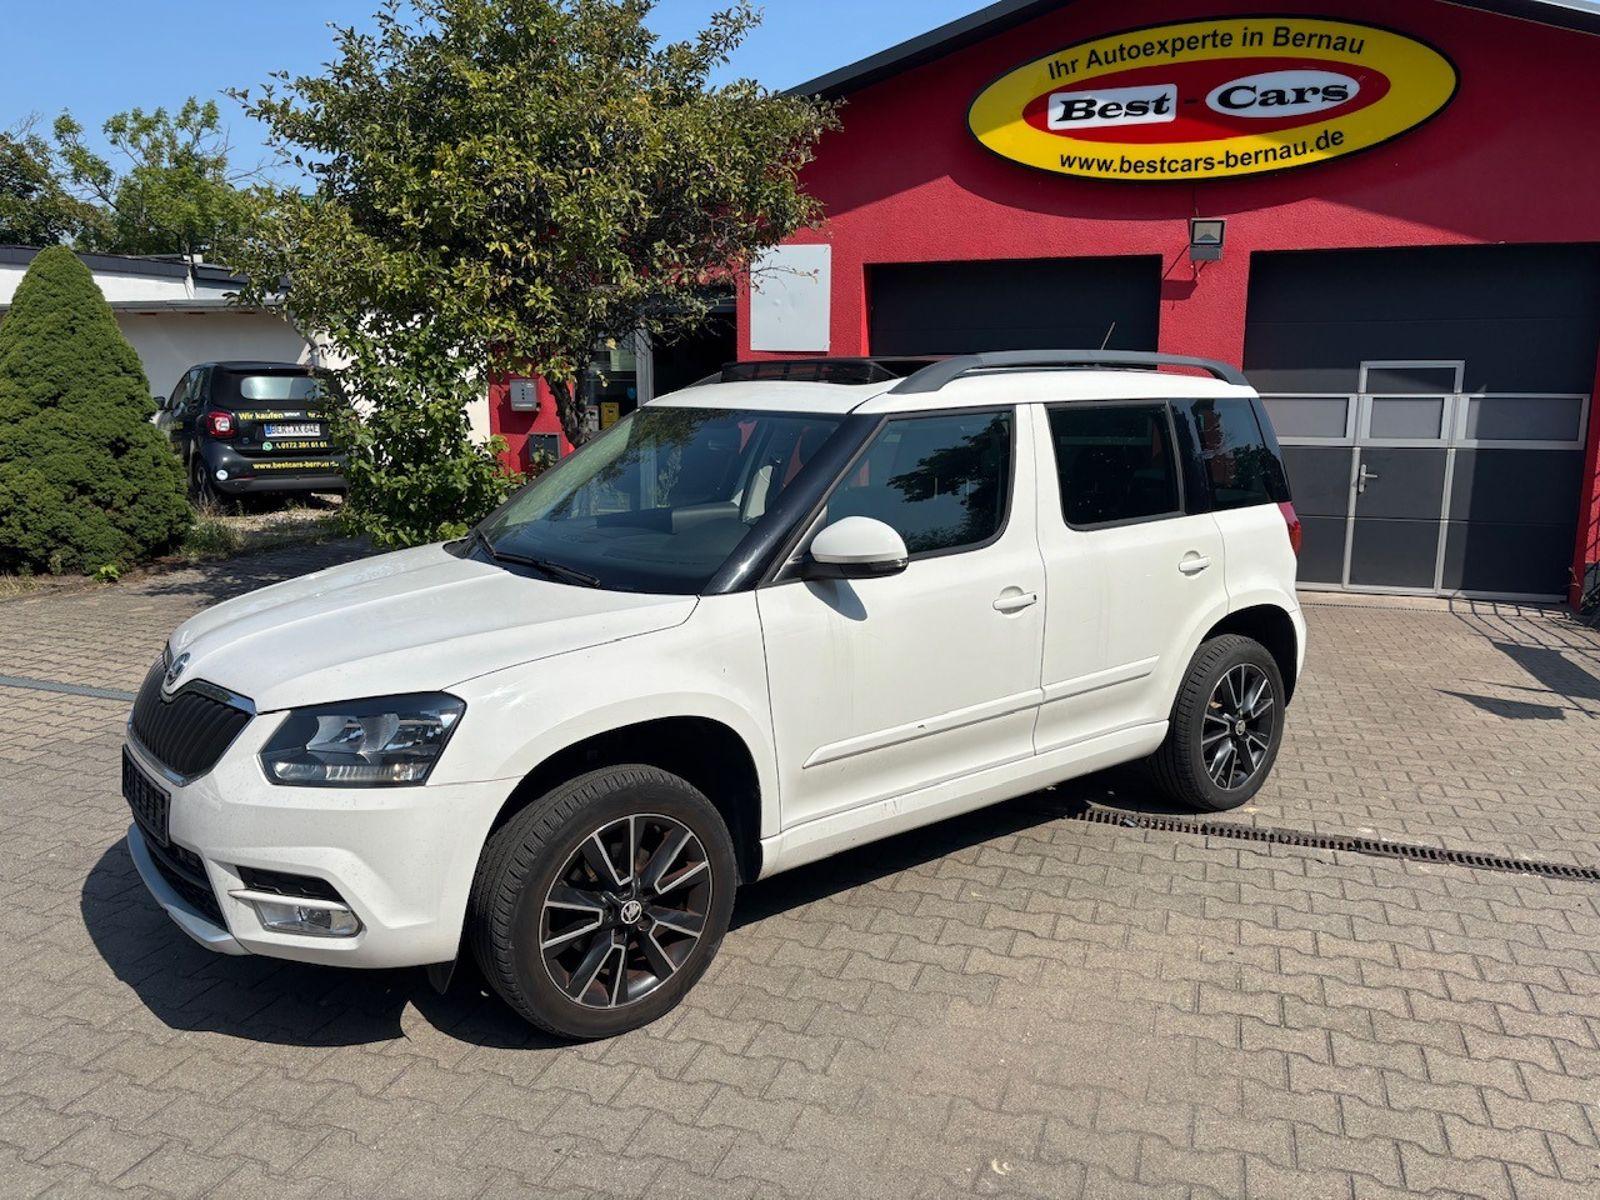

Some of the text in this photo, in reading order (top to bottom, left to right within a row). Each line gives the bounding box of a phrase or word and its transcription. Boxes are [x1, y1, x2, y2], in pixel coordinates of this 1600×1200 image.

[1048, 26, 1366, 80] Ihr Autoexperte in Bernau
[1055, 90, 1173, 123] Best
[1217, 79, 1350, 110] Cars
[1059, 129, 1345, 174] www.bestcars-bernau.de
[238, 412, 254, 420] Wir
[255, 411, 284, 420] kaufen
[252, 460, 339, 469] www.bestcars-bernud
